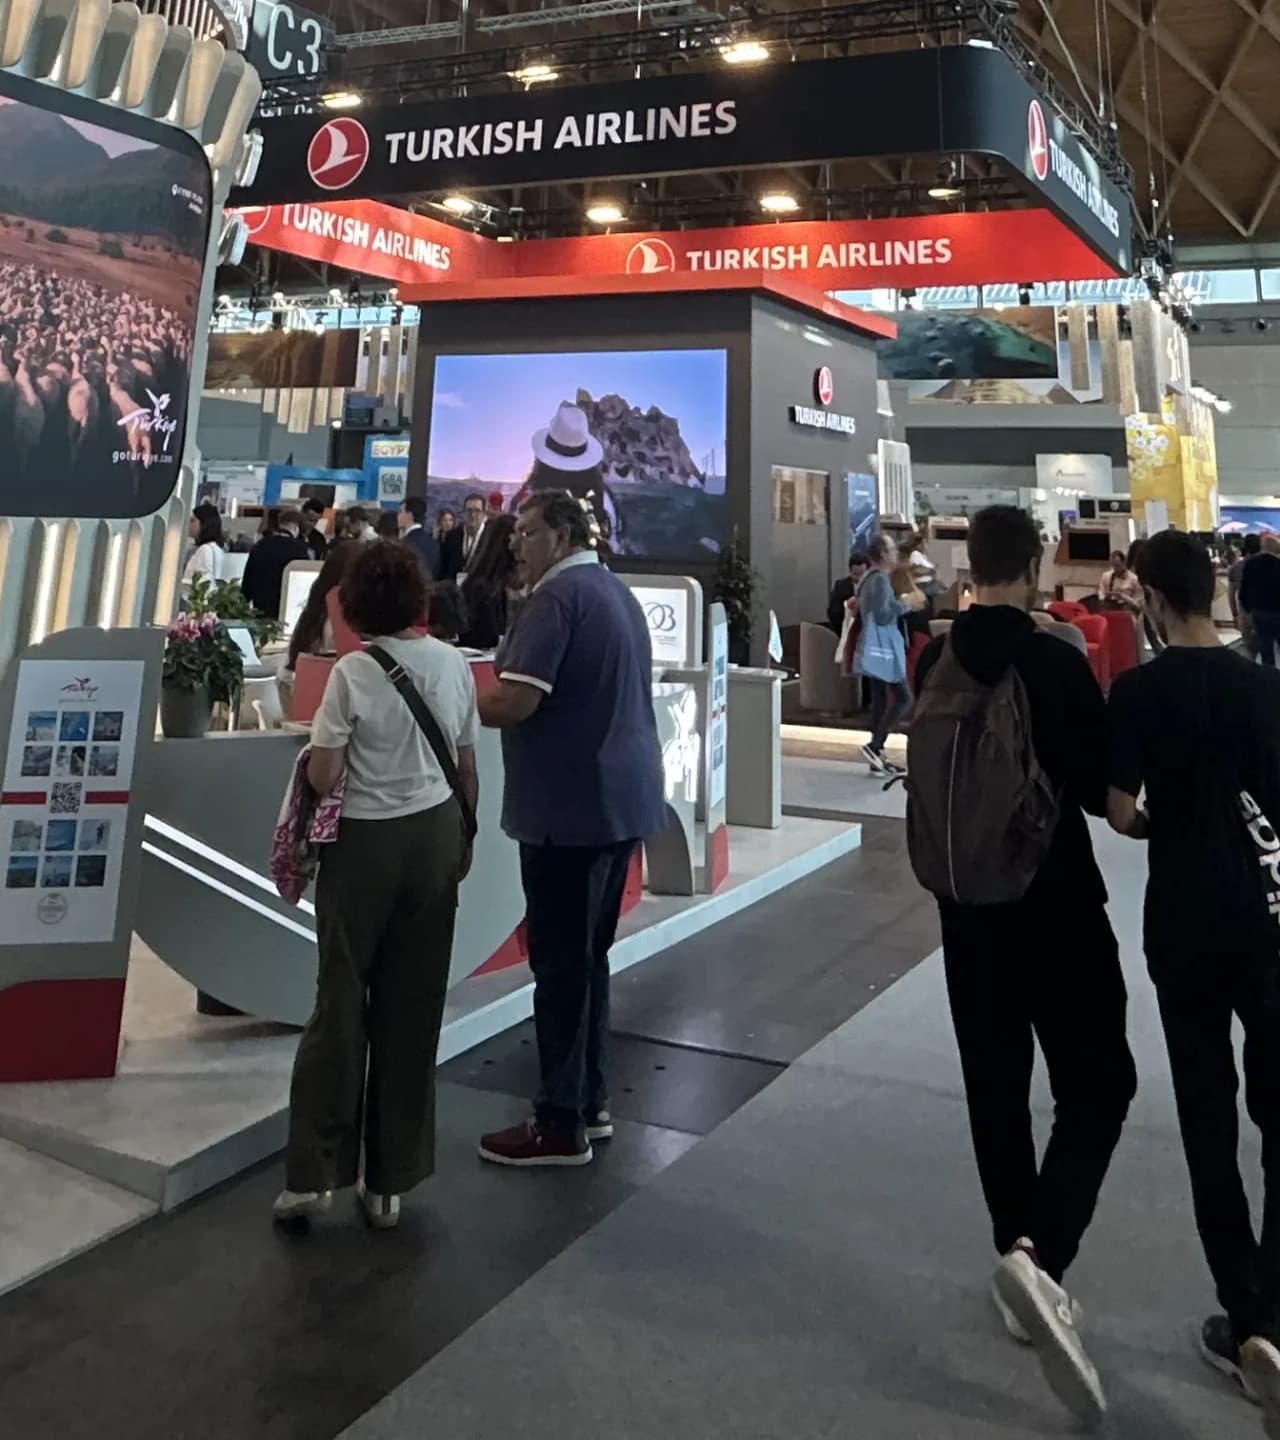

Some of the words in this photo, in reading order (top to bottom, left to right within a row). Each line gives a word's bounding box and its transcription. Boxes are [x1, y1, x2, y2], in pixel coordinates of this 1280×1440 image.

[267, 4, 322, 80] C3
[385, 119, 543, 164] TURKISH
[553, 101, 737, 149] AIRLINES
[1049, 138, 1088, 205] TURKISH
[1086, 180, 1119, 238] AIRLINES
[282, 203, 369, 248] TURKISH
[372, 227, 451, 270] AIRLINES
[686, 245, 808, 271] TURKISH
[816, 238, 952, 268] AIRLINES
[794, 405, 826, 427] TURKISH
[826, 412, 856, 434] AIRLINES
